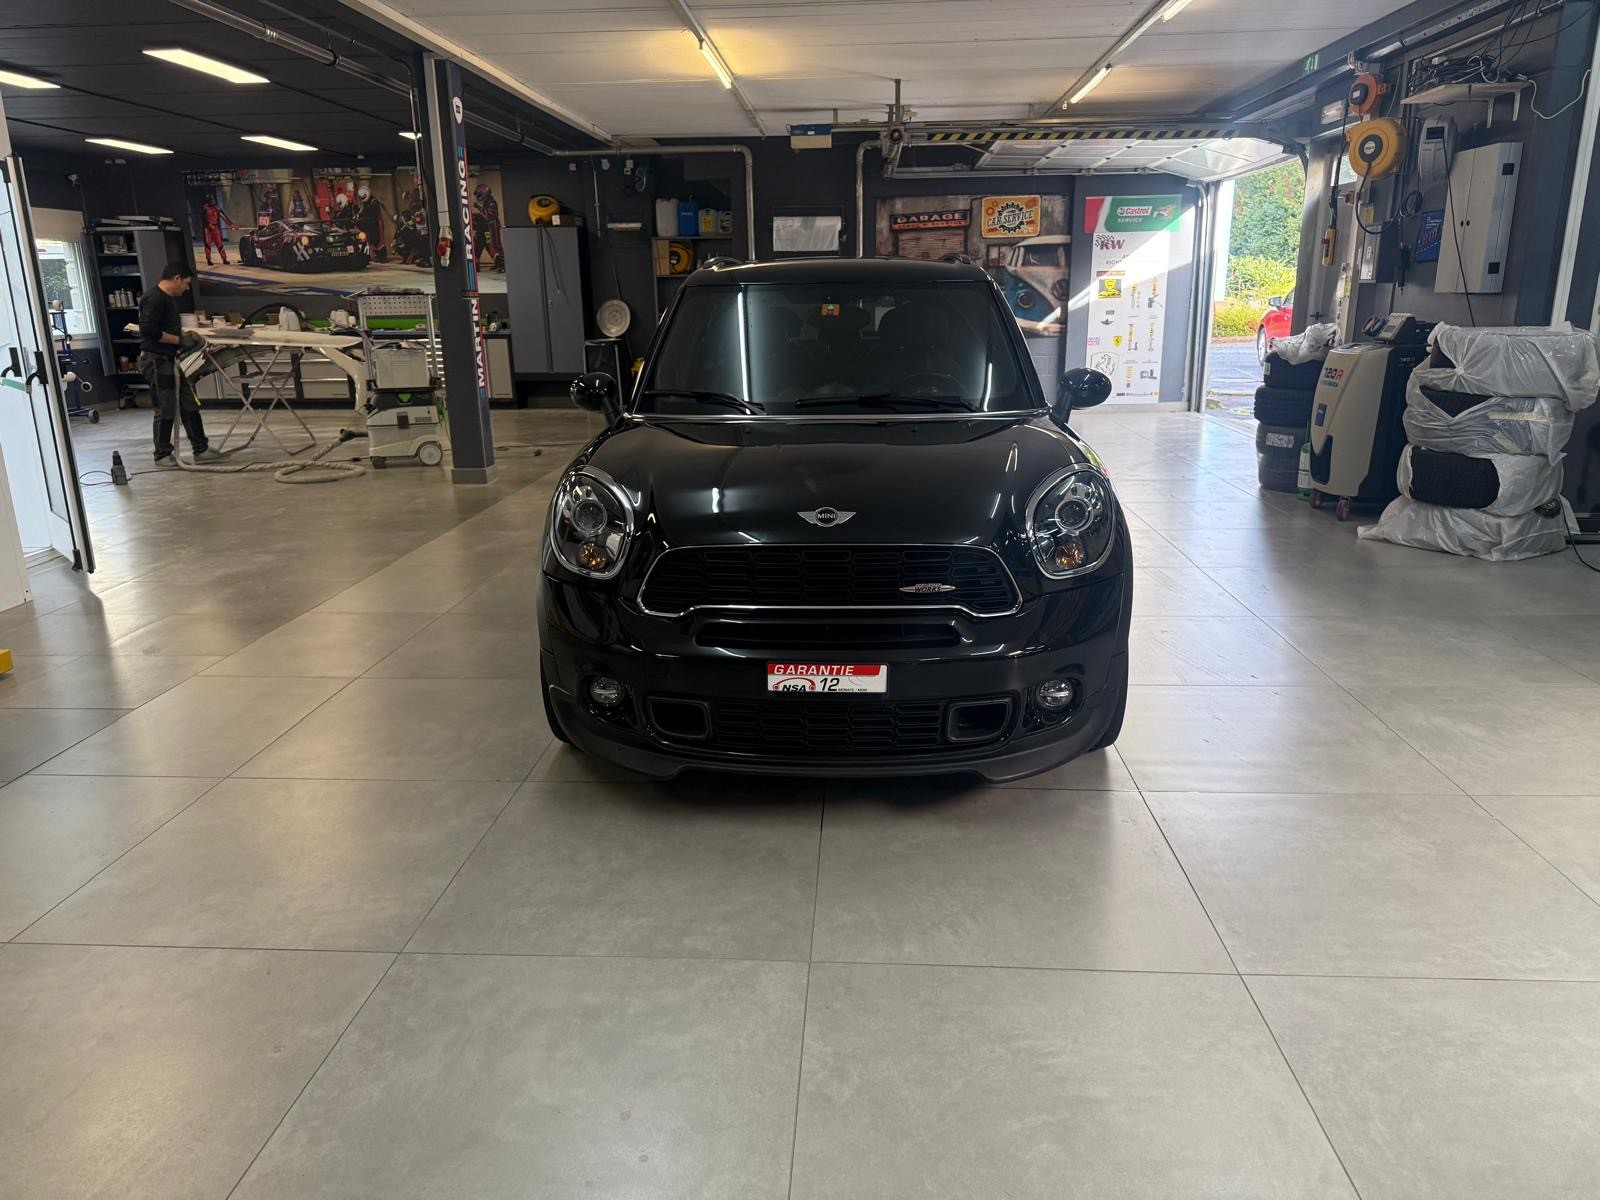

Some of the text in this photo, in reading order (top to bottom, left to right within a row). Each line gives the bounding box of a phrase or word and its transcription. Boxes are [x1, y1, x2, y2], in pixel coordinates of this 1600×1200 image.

[1125, 207, 1150, 215] Castrol
[897, 212, 964, 224] GARAGE
[986, 209, 1034, 228] CAR SERVICE
[1100, 239, 1125, 250] KW
[458, 160, 485, 387] MARTIN RACING
[774, 664, 855, 676] GARANTIE
[782, 684, 807, 692] NSA
[820, 677, 840, 692] 12
